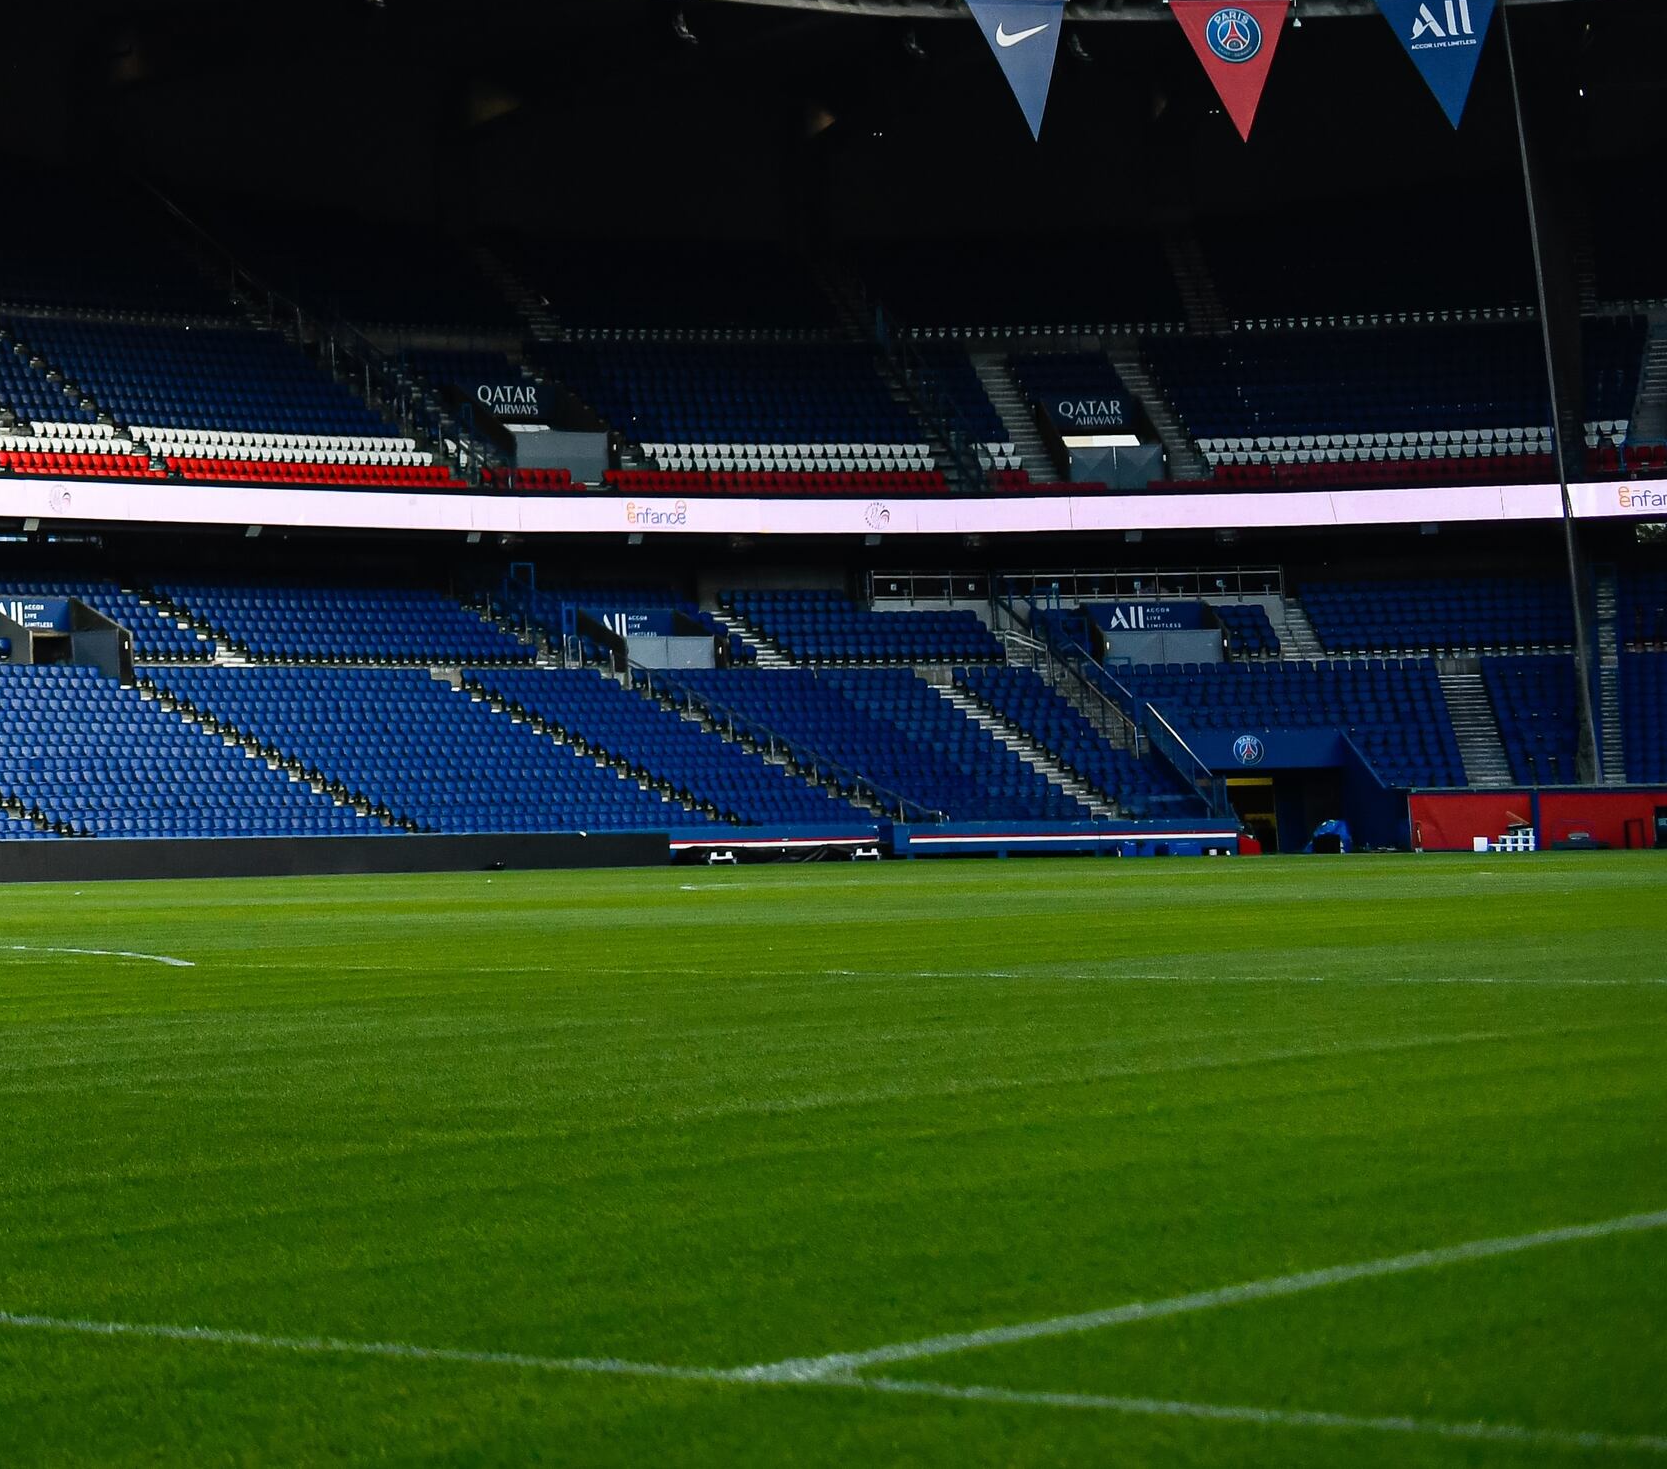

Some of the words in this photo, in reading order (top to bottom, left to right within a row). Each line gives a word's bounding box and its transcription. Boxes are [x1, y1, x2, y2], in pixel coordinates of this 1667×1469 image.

[1214, 11, 1249, 24] PARIS
[1411, 42, 1432, 50] ACCOR
[477, 385, 537, 405] QATAR
[493, 404, 538, 415] AIRWAYS
[1058, 400, 1121, 419] QATAR
[1076, 416, 1123, 426] AIRWAYS
